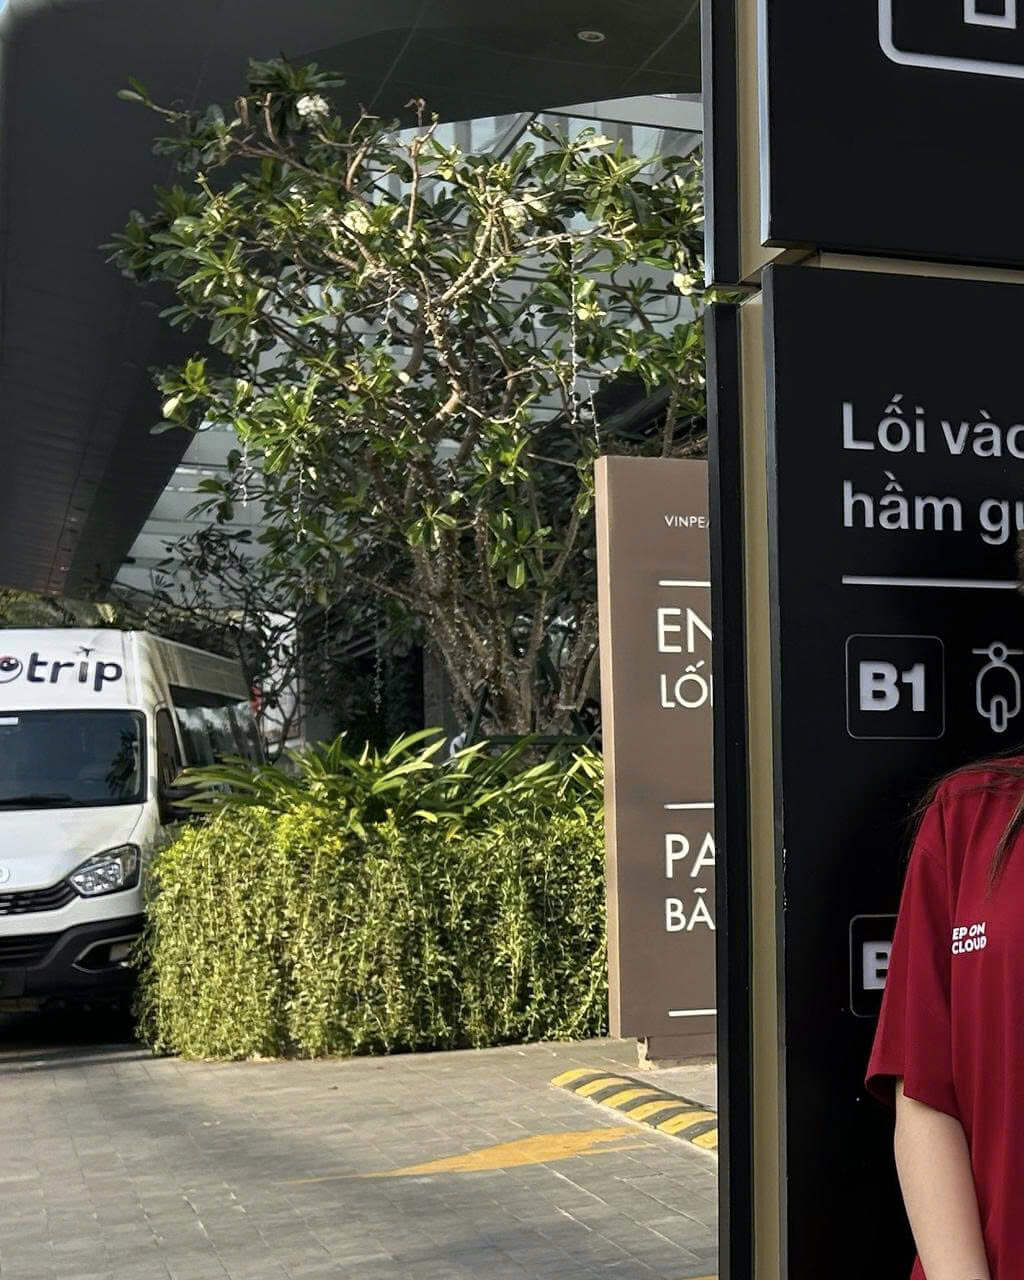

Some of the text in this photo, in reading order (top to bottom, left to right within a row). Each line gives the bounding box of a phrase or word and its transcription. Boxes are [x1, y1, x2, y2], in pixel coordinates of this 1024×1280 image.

[842, 393, 926, 454] Lối
[843, 470, 963, 532] hầm
[859, 661, 926, 712] B1
[665, 831, 716, 878] PA
[665, 887, 716, 932] BÃ
[969, 921, 986, 937] ON
[951, 935, 987, 955] CLOUD
